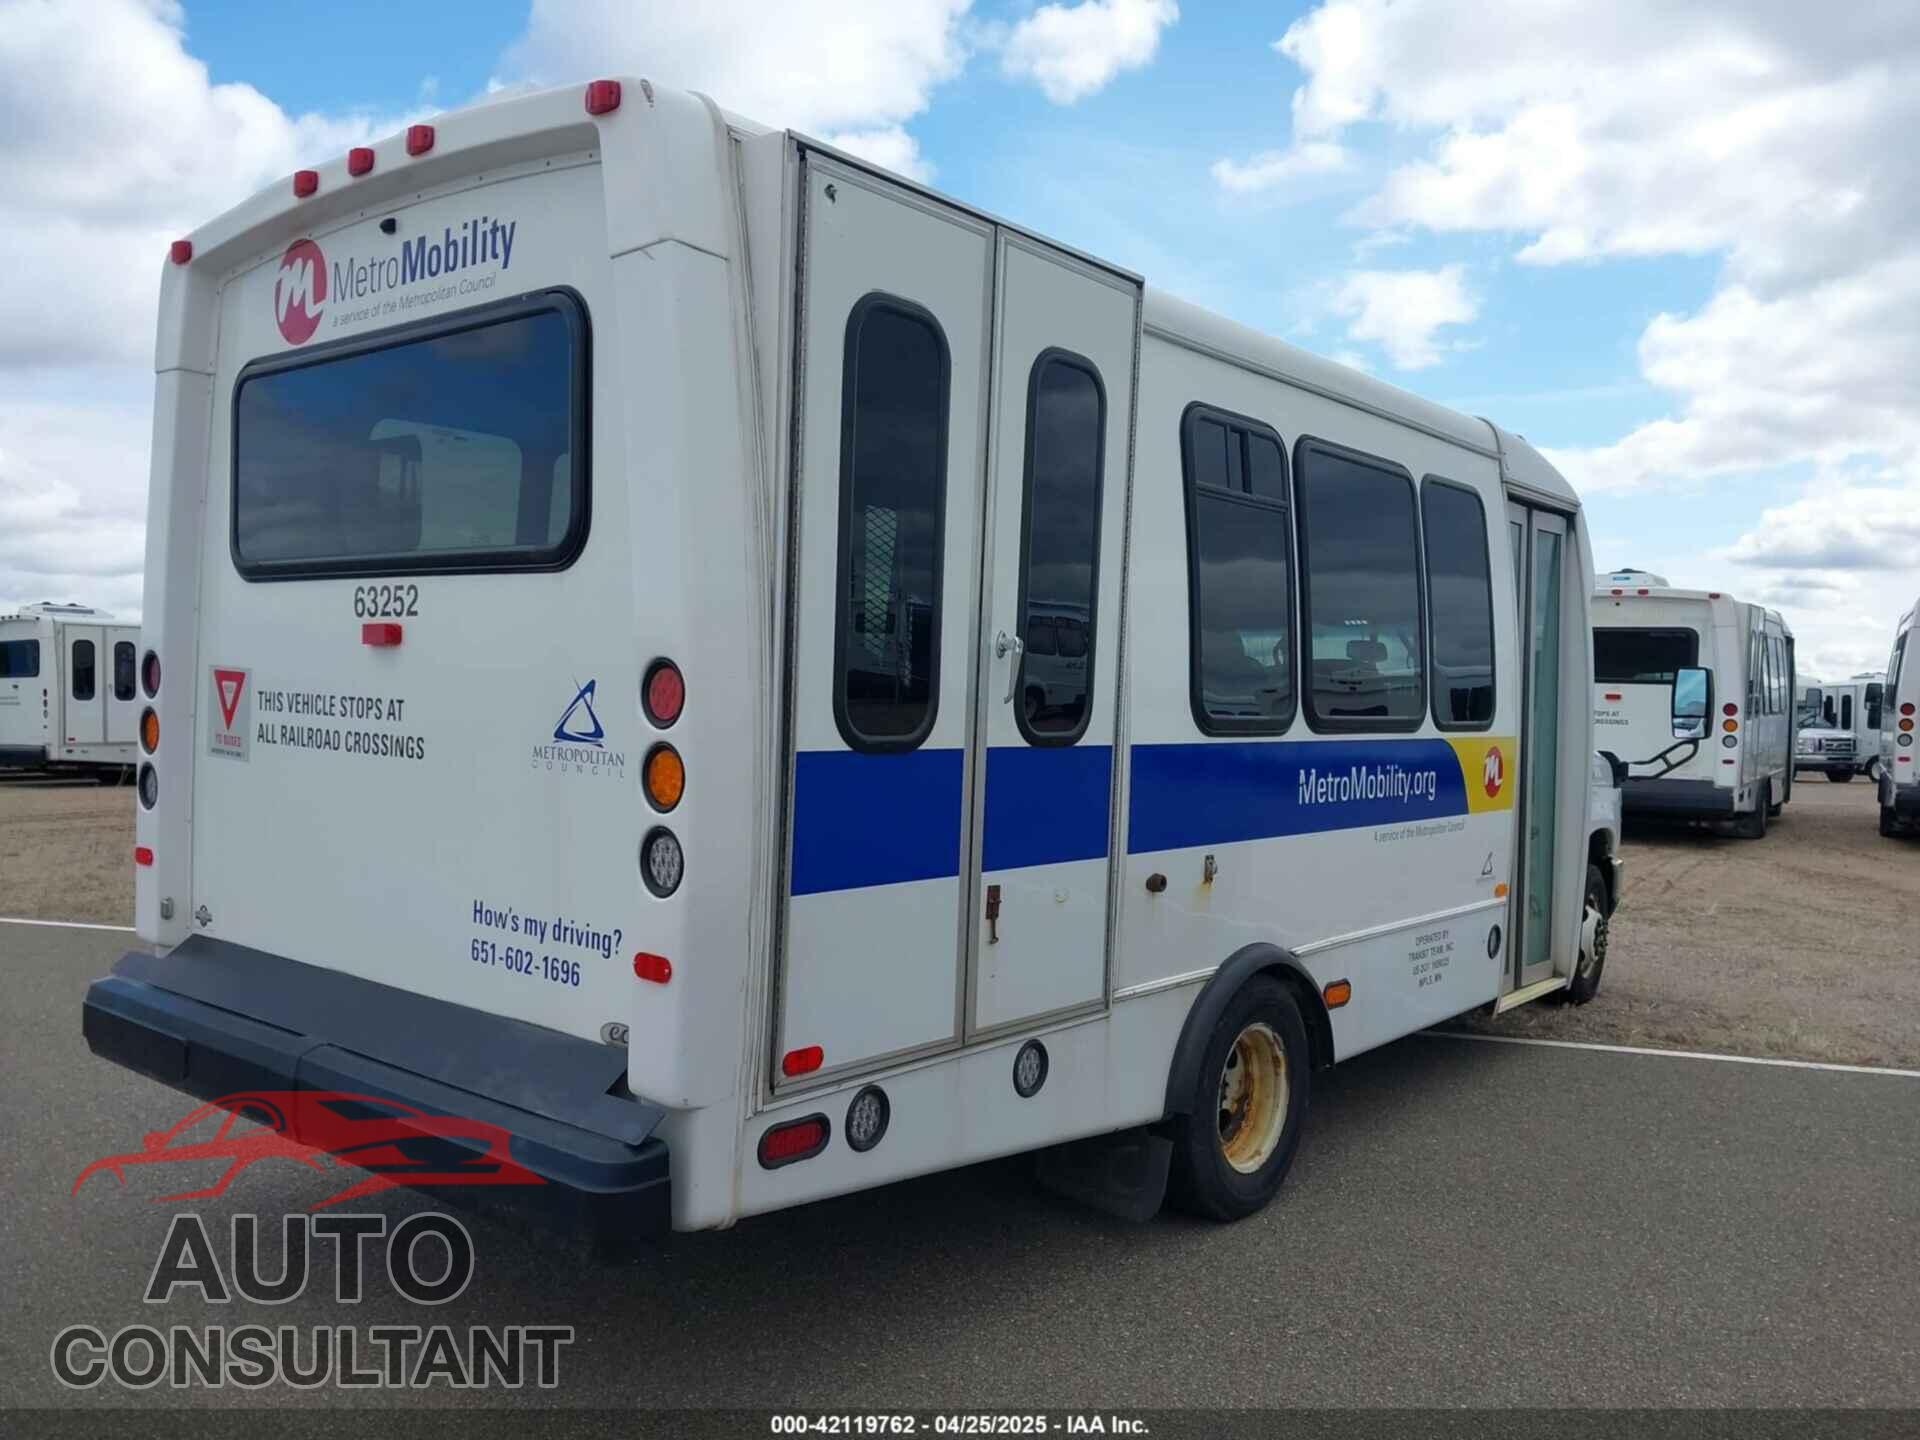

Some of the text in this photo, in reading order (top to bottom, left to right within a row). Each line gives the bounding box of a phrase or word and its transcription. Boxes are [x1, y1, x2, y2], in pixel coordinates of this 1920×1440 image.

[333, 216, 516, 304] MetroMobility
[340, 309, 370, 326] service
[371, 302, 381, 317] of
[382, 299, 396, 314] the
[458, 272, 497, 295] Council
[354, 584, 419, 618] 63252
[257, 690, 405, 722] THIS VEHICLE STOPS AT
[257, 723, 425, 760] ALL RAILROAD CROSSINGS
[532, 745, 625, 767] METROPOLITAN
[1298, 764, 1437, 805] MetroMobility.org
[473, 899, 623, 959] How's my driving?
[471, 938, 581, 986] 651-602-1696
